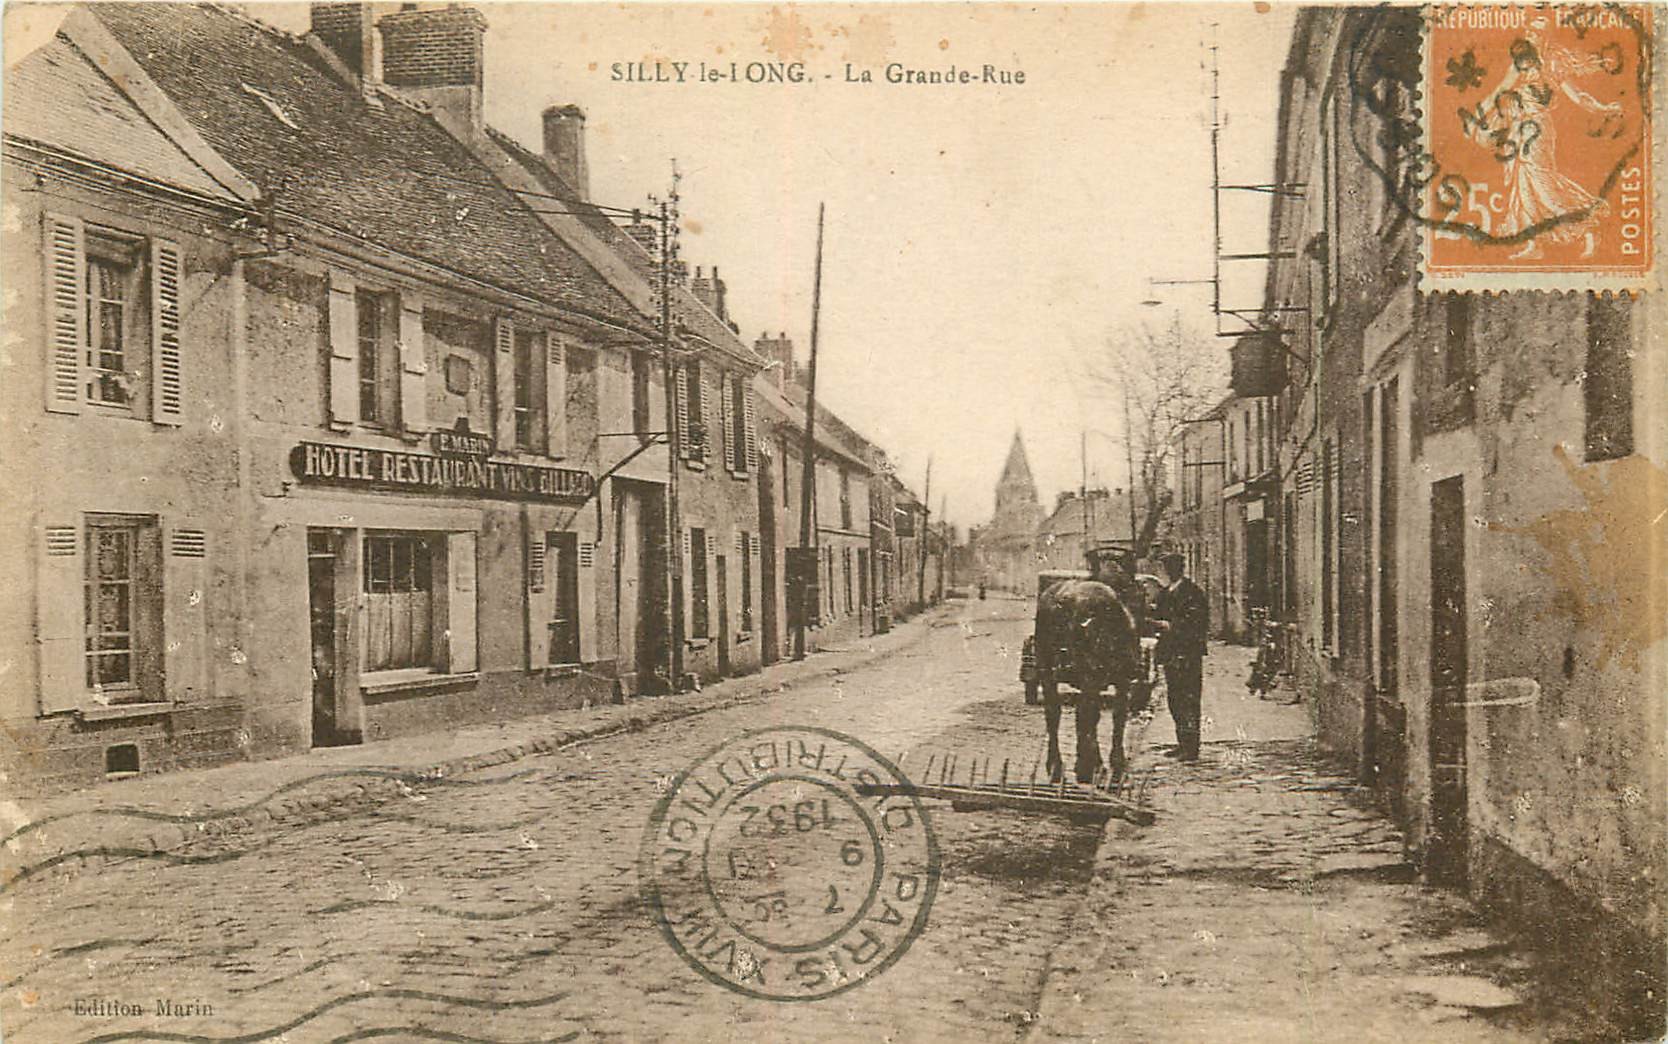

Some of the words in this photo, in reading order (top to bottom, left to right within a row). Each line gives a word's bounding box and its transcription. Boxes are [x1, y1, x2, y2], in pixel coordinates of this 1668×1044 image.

[1621, 166, 1641, 256] POSTES
[304, 445, 374, 480] HOTEL
[382, 453, 498, 489] RESTAURANT
[795, 870, 920, 988] PARIS
